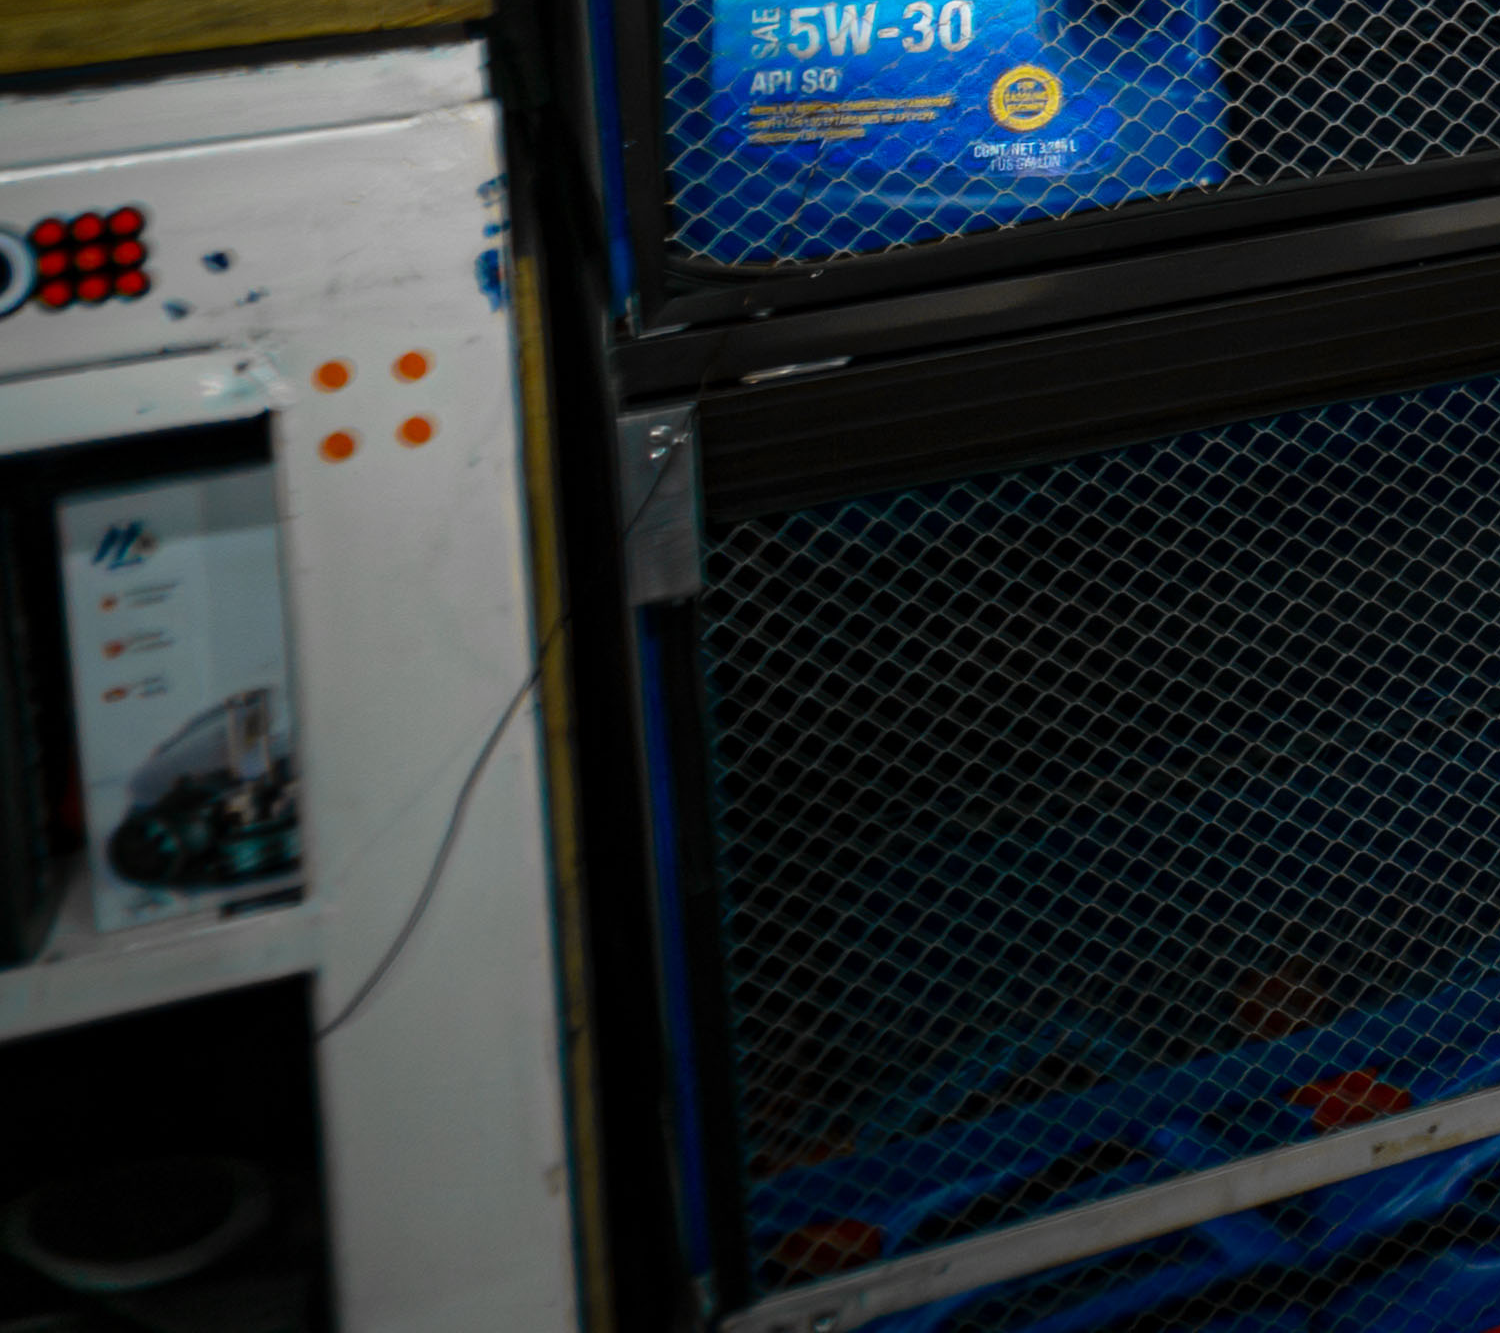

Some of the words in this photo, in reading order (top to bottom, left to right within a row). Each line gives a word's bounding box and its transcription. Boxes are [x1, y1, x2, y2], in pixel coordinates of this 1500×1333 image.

[751, 7, 782, 60] SAE
[750, 70, 793, 97] API
[801, 67, 844, 95] SQ
